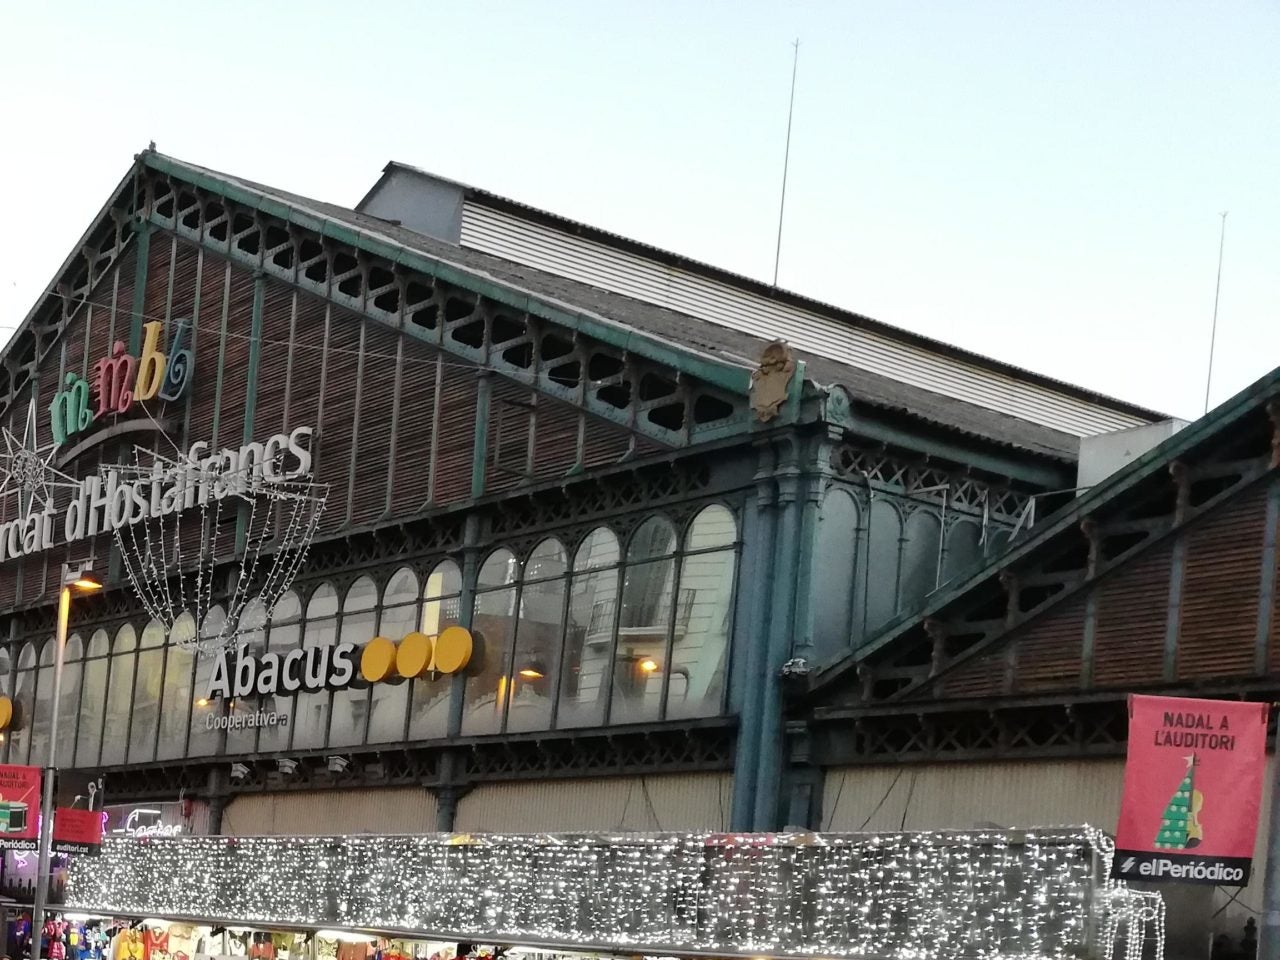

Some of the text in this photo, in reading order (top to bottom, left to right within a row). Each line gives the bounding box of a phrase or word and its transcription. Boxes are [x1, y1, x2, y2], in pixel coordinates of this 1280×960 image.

[65, 426, 313, 541] d'Hostafrancs
[206, 642, 355, 700] Abacus
[205, 707, 277, 731] Cooperativa
[1163, 711, 1229, 731] NADAL A
[1154, 730, 1235, 751] L'AUDITORI
[1139, 858, 1243, 881] elPeriódico
